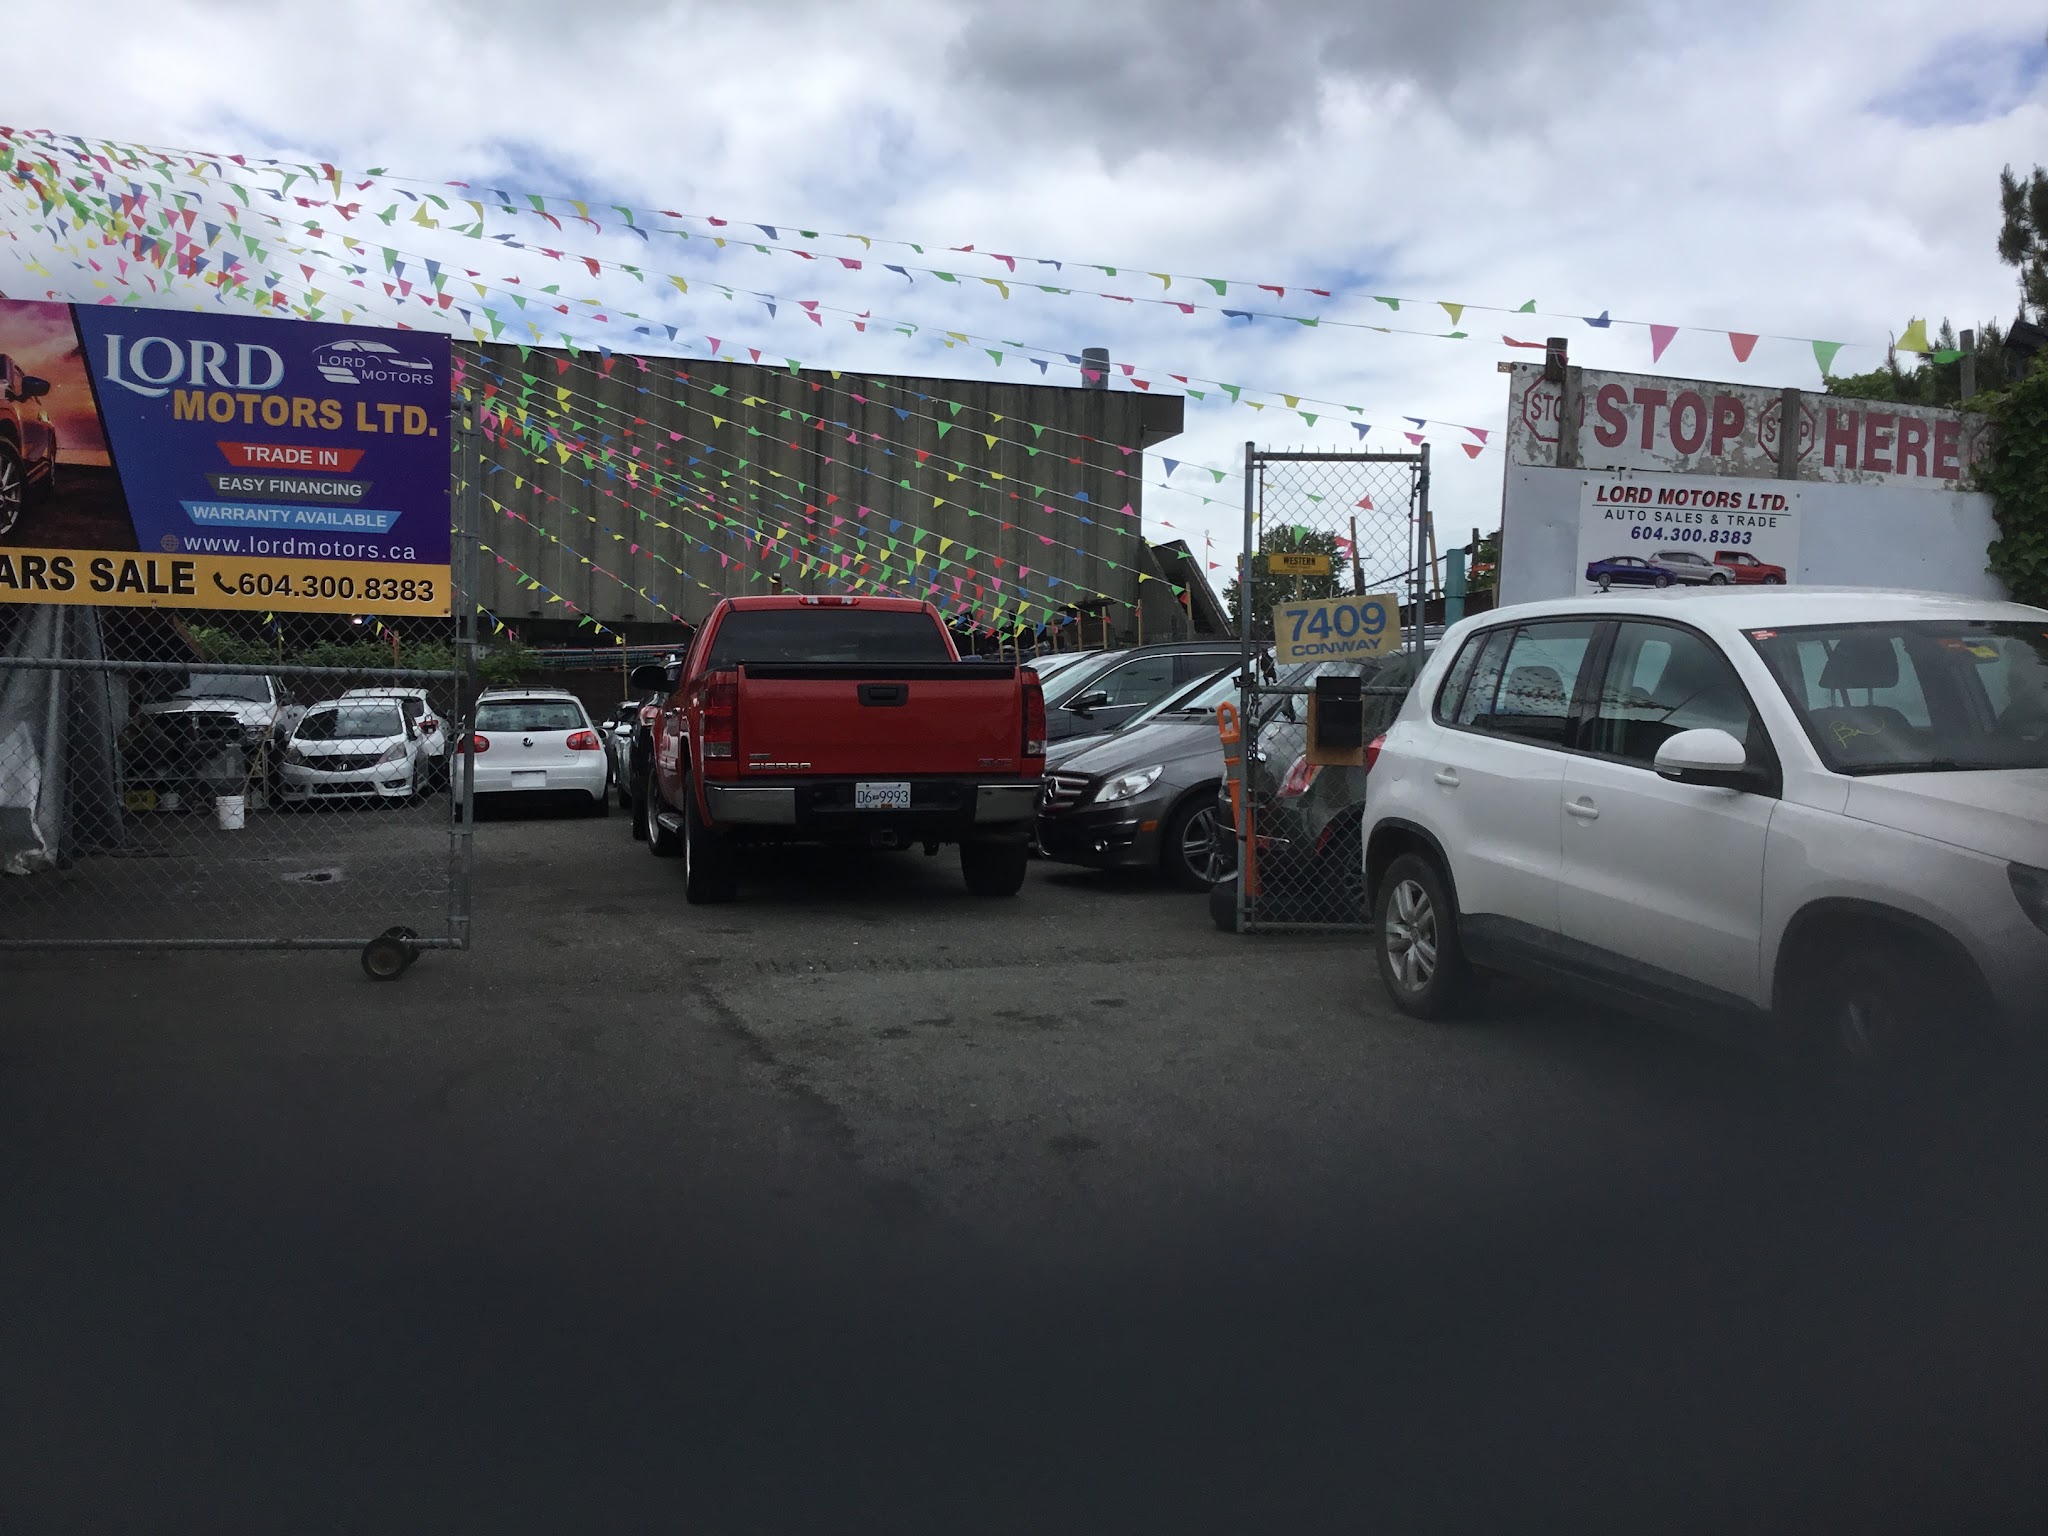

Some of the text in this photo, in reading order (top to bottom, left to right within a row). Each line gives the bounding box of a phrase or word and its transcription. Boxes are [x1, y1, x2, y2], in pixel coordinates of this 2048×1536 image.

[103, 333, 285, 398] LORD
[319, 355, 366, 368] LORD
[361, 369, 434, 385] MOTORS
[173, 389, 438, 437] MOTORS LTD.
[1594, 383, 1961, 480] STOP HERE
[1764, 415, 1810, 446] SP
[243, 446, 338, 466] TRADE IN
[219, 477, 363, 497] EASY FINANCING
[1597, 485, 1789, 512] LORD MOTORS LTD.
[192, 506, 387, 527] WARRANTY AVAILABLE
[1604, 509, 1777, 528] AUTO SALES & TRADE
[1631, 526, 1752, 545] 604.300.8383
[183, 535, 416, 560] www.lordmotors.ca
[1283, 556, 1316, 566] WESTERN
[89, 557, 196, 596] SALE
[238, 573, 435, 602] 604.300.8383
[1286, 602, 1387, 642] 7409
[1291, 637, 1382, 657] CONWAY
